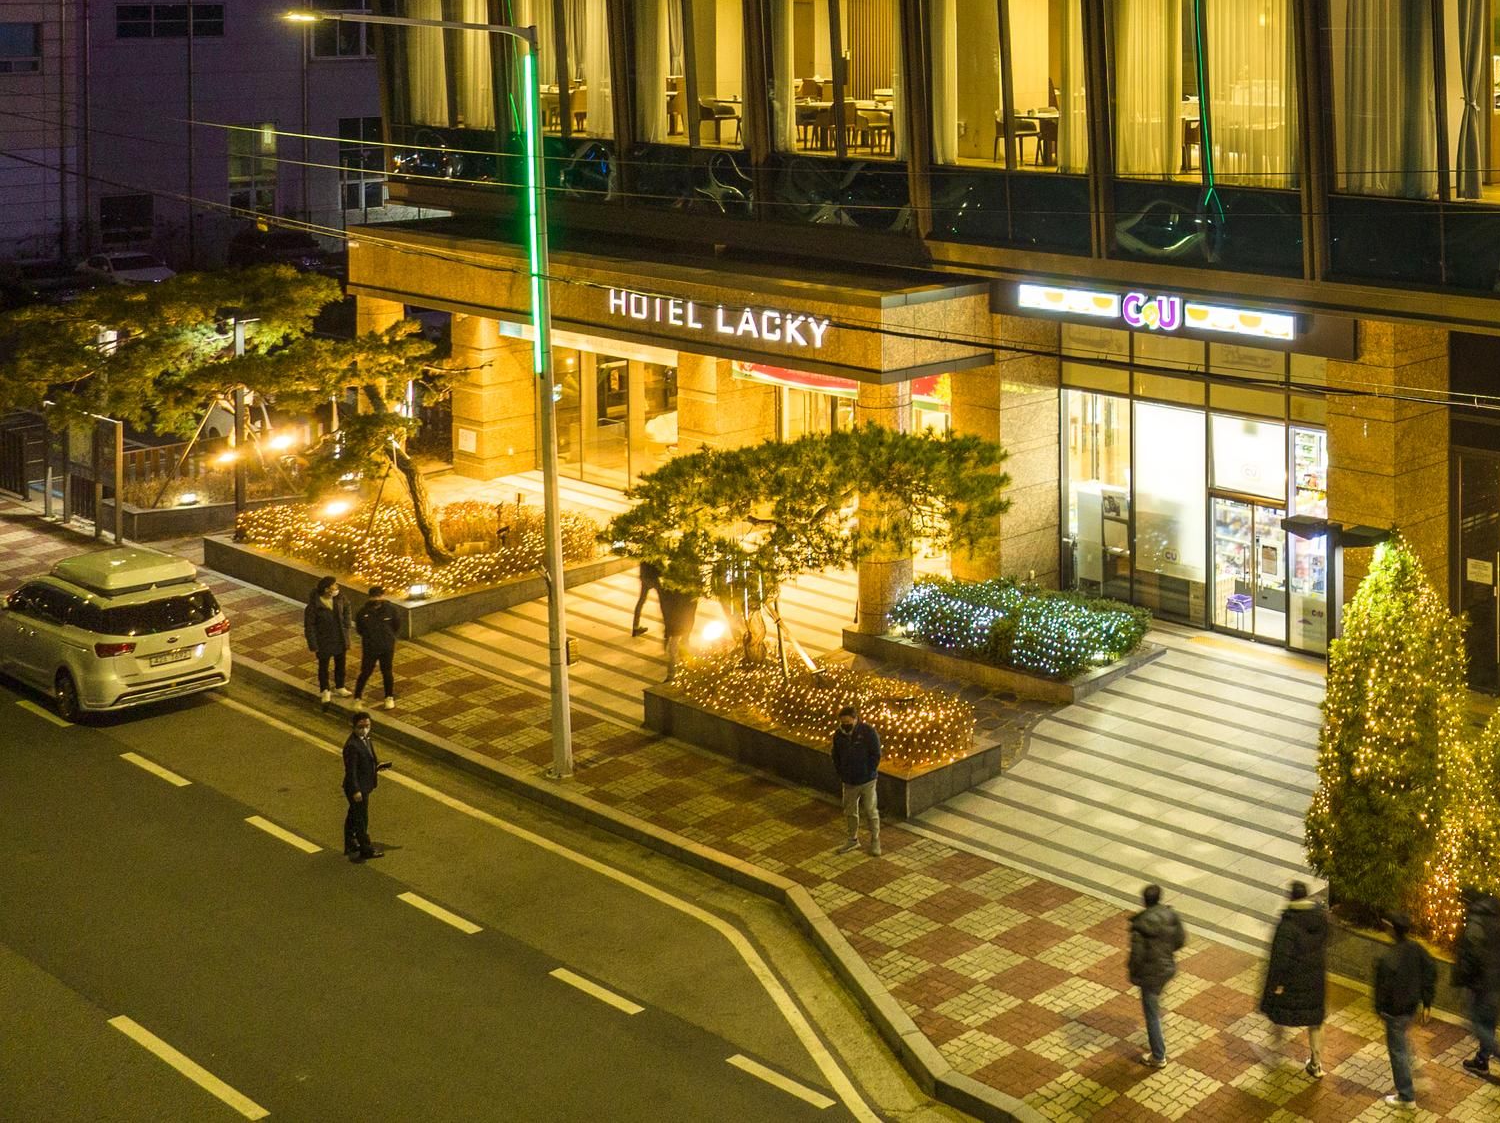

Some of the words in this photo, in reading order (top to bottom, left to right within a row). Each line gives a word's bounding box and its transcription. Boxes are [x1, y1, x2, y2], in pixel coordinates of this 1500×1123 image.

[609, 289, 702, 328] HOTEL
[716, 305, 830, 348] LACKY
[1123, 292, 1180, 329] CU
[1164, 550, 1178, 562] CU
